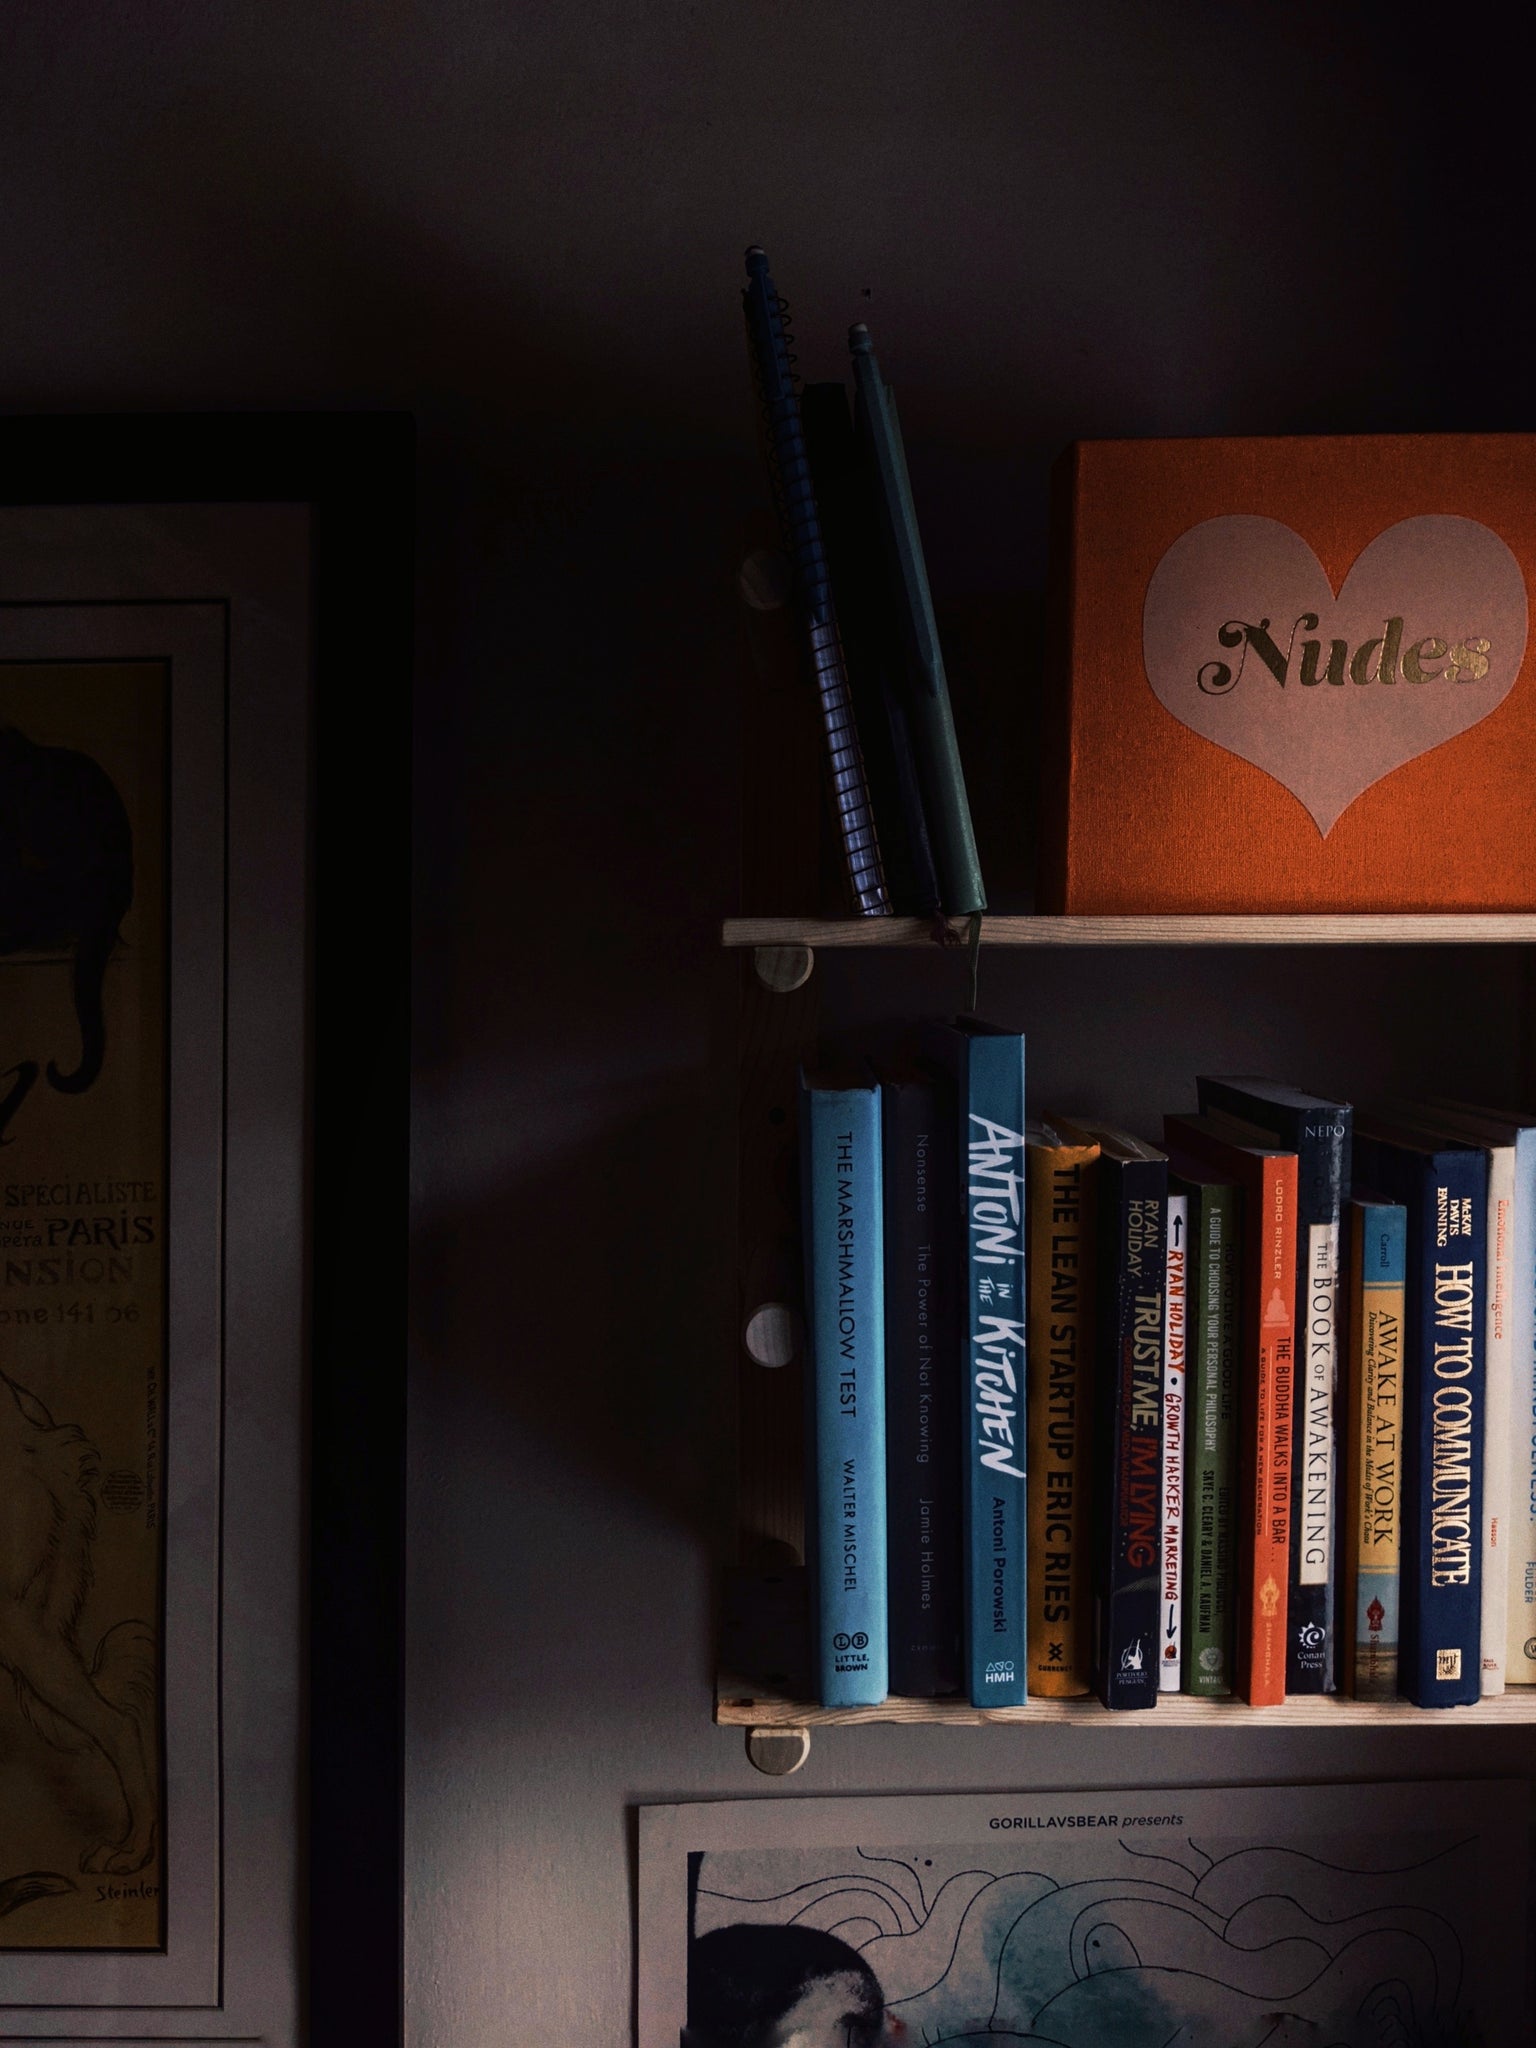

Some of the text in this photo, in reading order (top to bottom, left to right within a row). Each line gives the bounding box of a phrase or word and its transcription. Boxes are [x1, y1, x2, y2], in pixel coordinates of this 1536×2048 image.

[1197, 612, 1492, 695] Nudes
[1305, 1125, 1345, 1138] NEPO
[915, 1134, 929, 1213] Nonsense
[1143, 1199, 1159, 1248] RYAN
[1209, 1217, 1221, 1245] GUIDE
[1273, 1179, 1283, 1280] LODRO RINZLER
[1436, 1186, 1448, 1247] FANNING
[1448, 1199, 1460, 1236] DAVIS
[1460, 1198, 1472, 1236] McKAY
[1126, 1199, 1144, 1278] HOLIDAY
[1208, 1248, 1221, 1260] TO
[1379, 1233, 1390, 1267] Carroll
[837, 1132, 856, 1418] THE MARSHMALLOW TEST
[978, 1275, 994, 1307] THE
[1208, 1263, 1220, 1311] CHOOSING
[1207, 1313, 1219, 1338] YOUR
[1221, 1243, 1234, 1420] HOW TO LIVE A GOOD LIFE
[1365, 1311, 1377, 1357] Discovering
[917, 1244, 933, 1464] The Power of Not Knowing
[1205, 1341, 1218, 1390] PERSONAL
[1276, 1337, 1291, 1361] THE
[1365, 1358, 1376, 1385] Clarity
[1043, 1164, 1081, 1623] THE LEAN STARTUP ERIC RIES
[1275, 1366, 1290, 1420] BUDDHA
[1306, 1244, 1332, 1566] THE BOOK OF AWAKENING
[1367, 1387, 1375, 1401] and
[1126, 1292, 1162, 1569] TRUST ME, I'M LYING
[1164, 1250, 1185, 1601] RYAN HOLIDAY GROWTH HACKER MARKETING
[1204, 1393, 1217, 1452] PHILOSOPHY
[1365, 1403, 1375, 1434] Balance
[1373, 1310, 1398, 1546] AWAKE AT WORK
[1431, 1261, 1474, 1588] HOW TO COMMUNICATE
[1273, 1426, 1288, 1466] WALKS
[1365, 1445, 1374, 1456] the
[1202, 1470, 1214, 1492] SKYE
[1202, 1494, 1213, 1504] C.
[1273, 1472, 1287, 1502] INTO
[843, 1459, 857, 1592] WALTER MISCHEL
[1201, 1505, 1213, 1537] CLEARY
[1273, 1506, 1285, 1515] A
[1363, 1521, 1373, 1545] Chaos
[1490, 1517, 1498, 1547] Hasson
[919, 1498, 935, 1609] Jamie Holmes
[992, 1496, 1007, 1633] Antoni Porowski
[1200, 1549, 1211, 1579] DANIEL
[1200, 1581, 1211, 1590] A.
[1198, 1593, 1211, 1633] KAUFMAN
[835, 1663, 868, 1672] BROWN
[1038, 1664, 1073, 1672] CURRENCY
[1263, 1622, 1273, 1686] SHAMBHALA
[1297, 1651, 1325, 1661] Conan
[1301, 1661, 1323, 1669] Press
[985, 1672, 1015, 1684] HMH
[989, 1814, 1184, 1830] GORILLAVSBEAR presents
